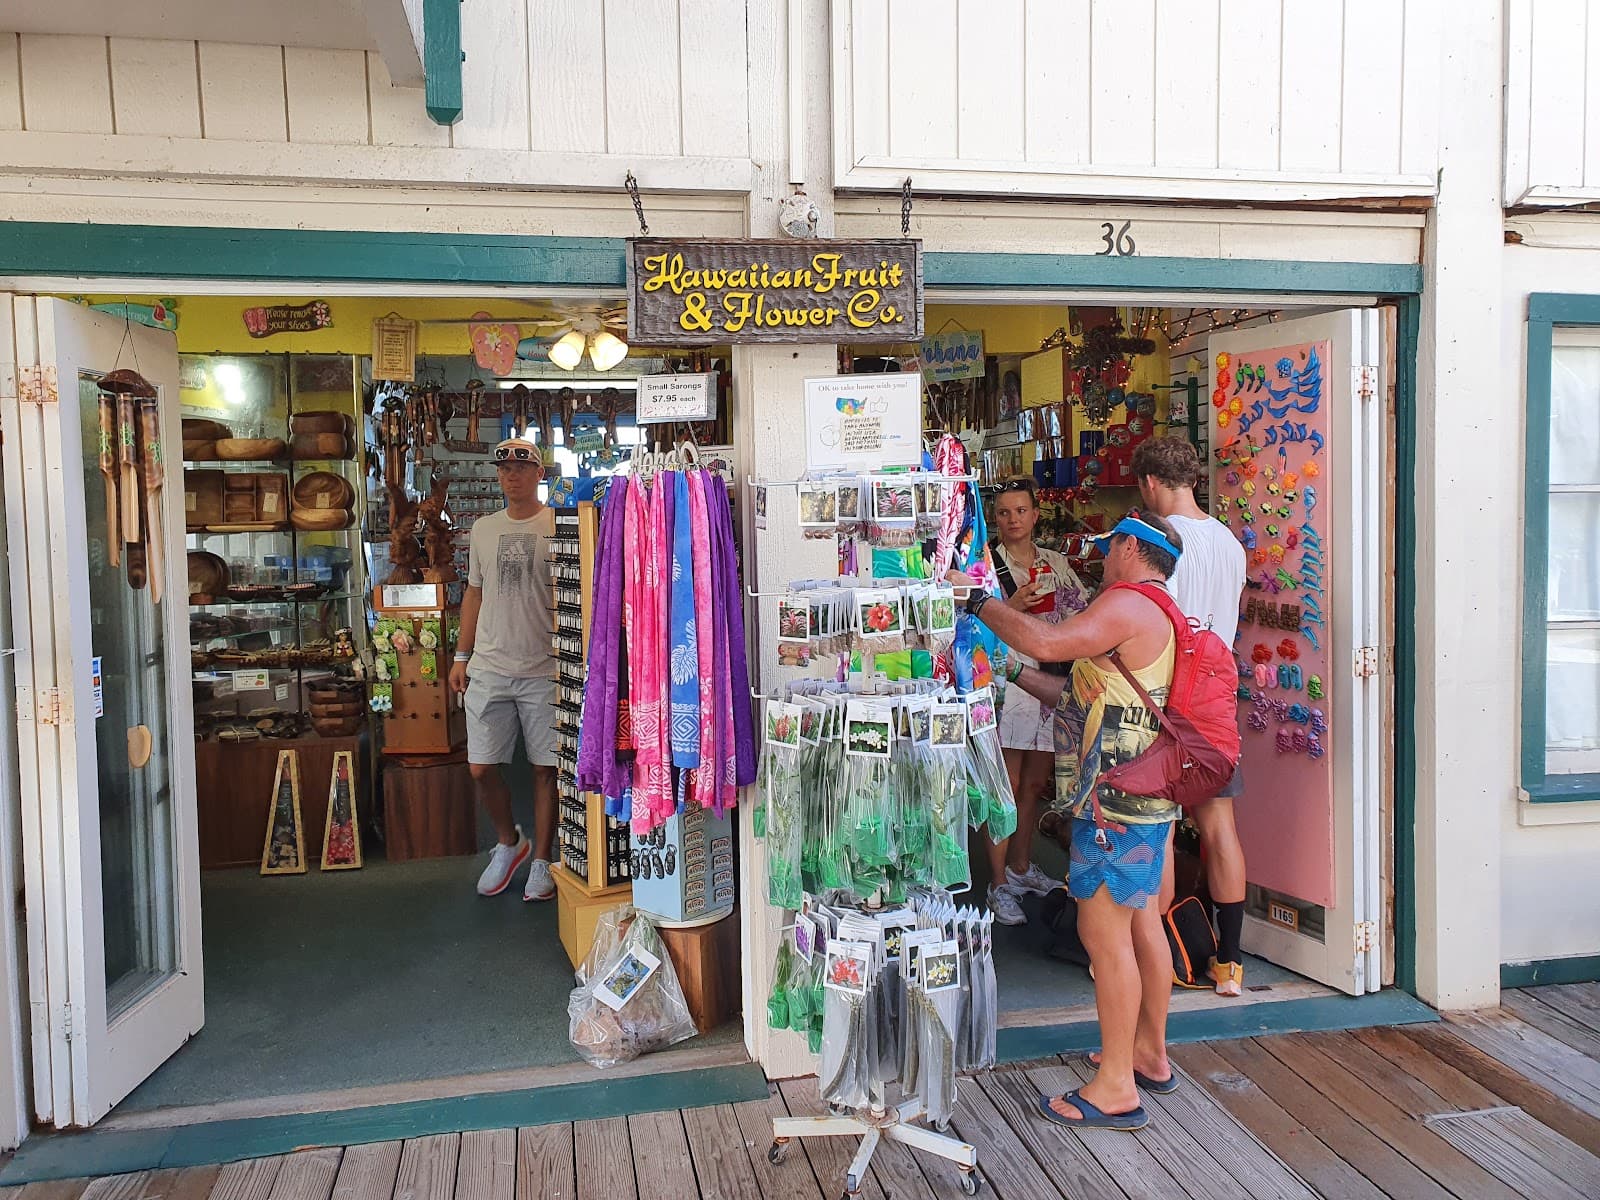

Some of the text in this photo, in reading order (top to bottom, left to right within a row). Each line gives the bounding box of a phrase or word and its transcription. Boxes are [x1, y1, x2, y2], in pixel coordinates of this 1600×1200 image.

[1096, 219, 1136, 257] 36
[643, 253, 904, 294] Hawaiian Fruit
[679, 289, 904, 332] & Flower Co.
[268, 320, 286, 330] your
[647, 383, 702, 391] Small Sarongs
[840, 383, 854, 391] take
[876, 382, 892, 390] with
[652, 394, 677, 403] $7.95
[501, 554, 528, 562] adidas
[1273, 907, 1294, 924] 1169
